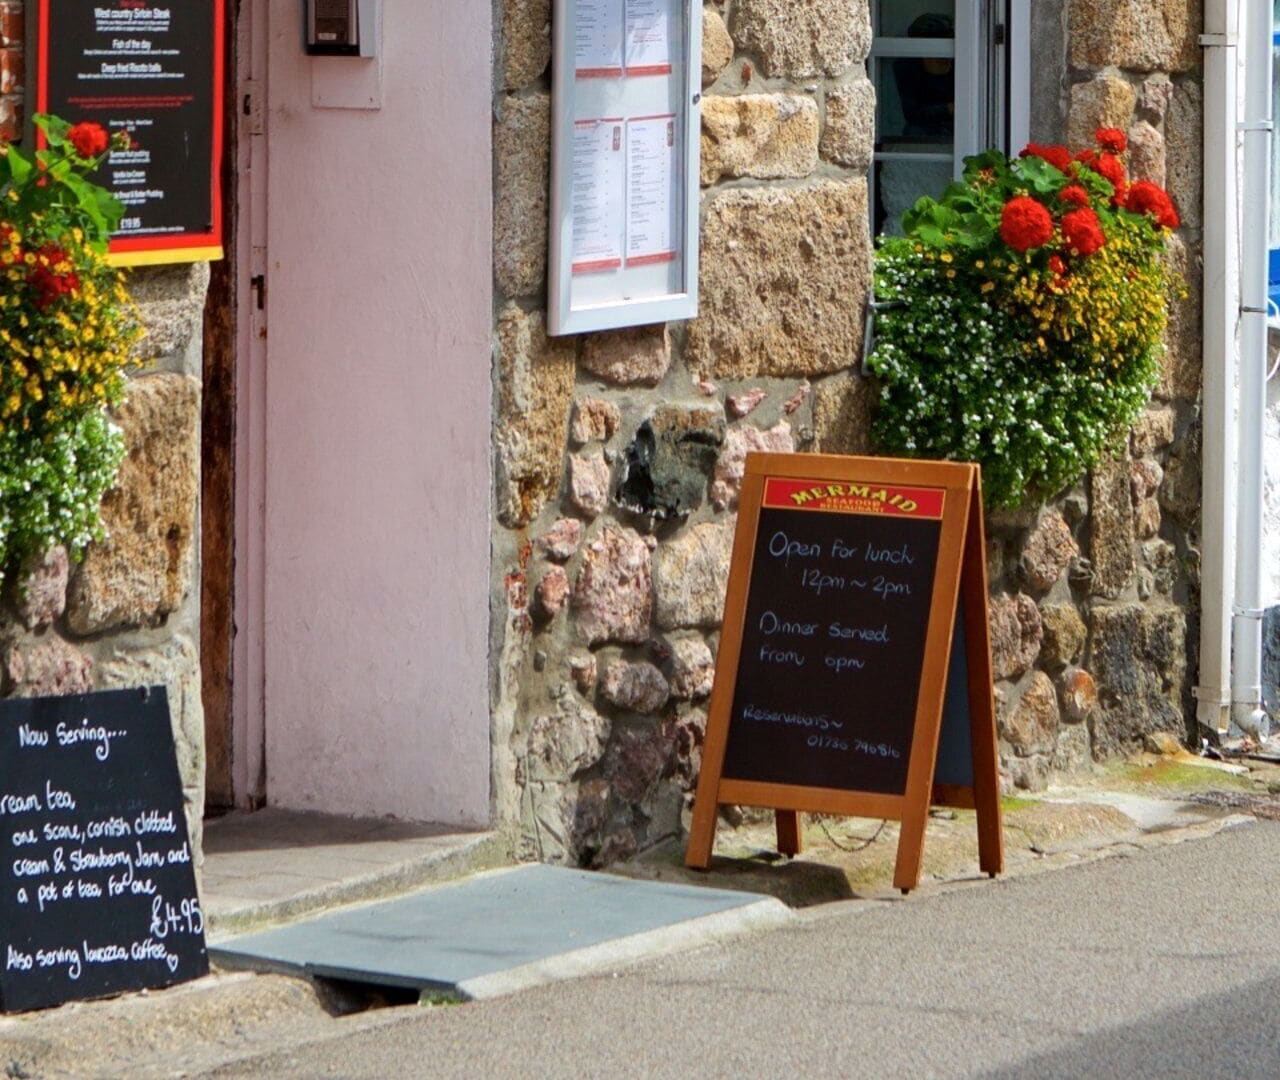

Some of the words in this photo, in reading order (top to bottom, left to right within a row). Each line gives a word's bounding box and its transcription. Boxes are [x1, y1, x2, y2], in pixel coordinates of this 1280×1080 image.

[790, 484, 918, 512] MERMAID
[819, 503, 885, 513] RESTAURANT
[826, 497, 881, 507] SEAFOOD
[768, 531, 821, 568] Open
[864, 541, 915, 565] lunch
[801, 568, 845, 595] 12pm
[872, 575, 912, 600] 2pm
[759, 611, 818, 635] Dinner
[18, 724, 49, 748] Now
[12, 829, 38, 847] one
[134, 810, 177, 835] clotted
[12, 859, 50, 877] cream
[52, 847, 66, 875] &
[167, 841, 191, 864] and
[17, 888, 29, 904] a
[37, 881, 58, 912] pot
[62, 879, 74, 898] of
[77, 878, 103, 898] tea
[130, 878, 157, 896] one
[150, 895, 204, 939] £4.95
[6, 943, 33, 971] Also
